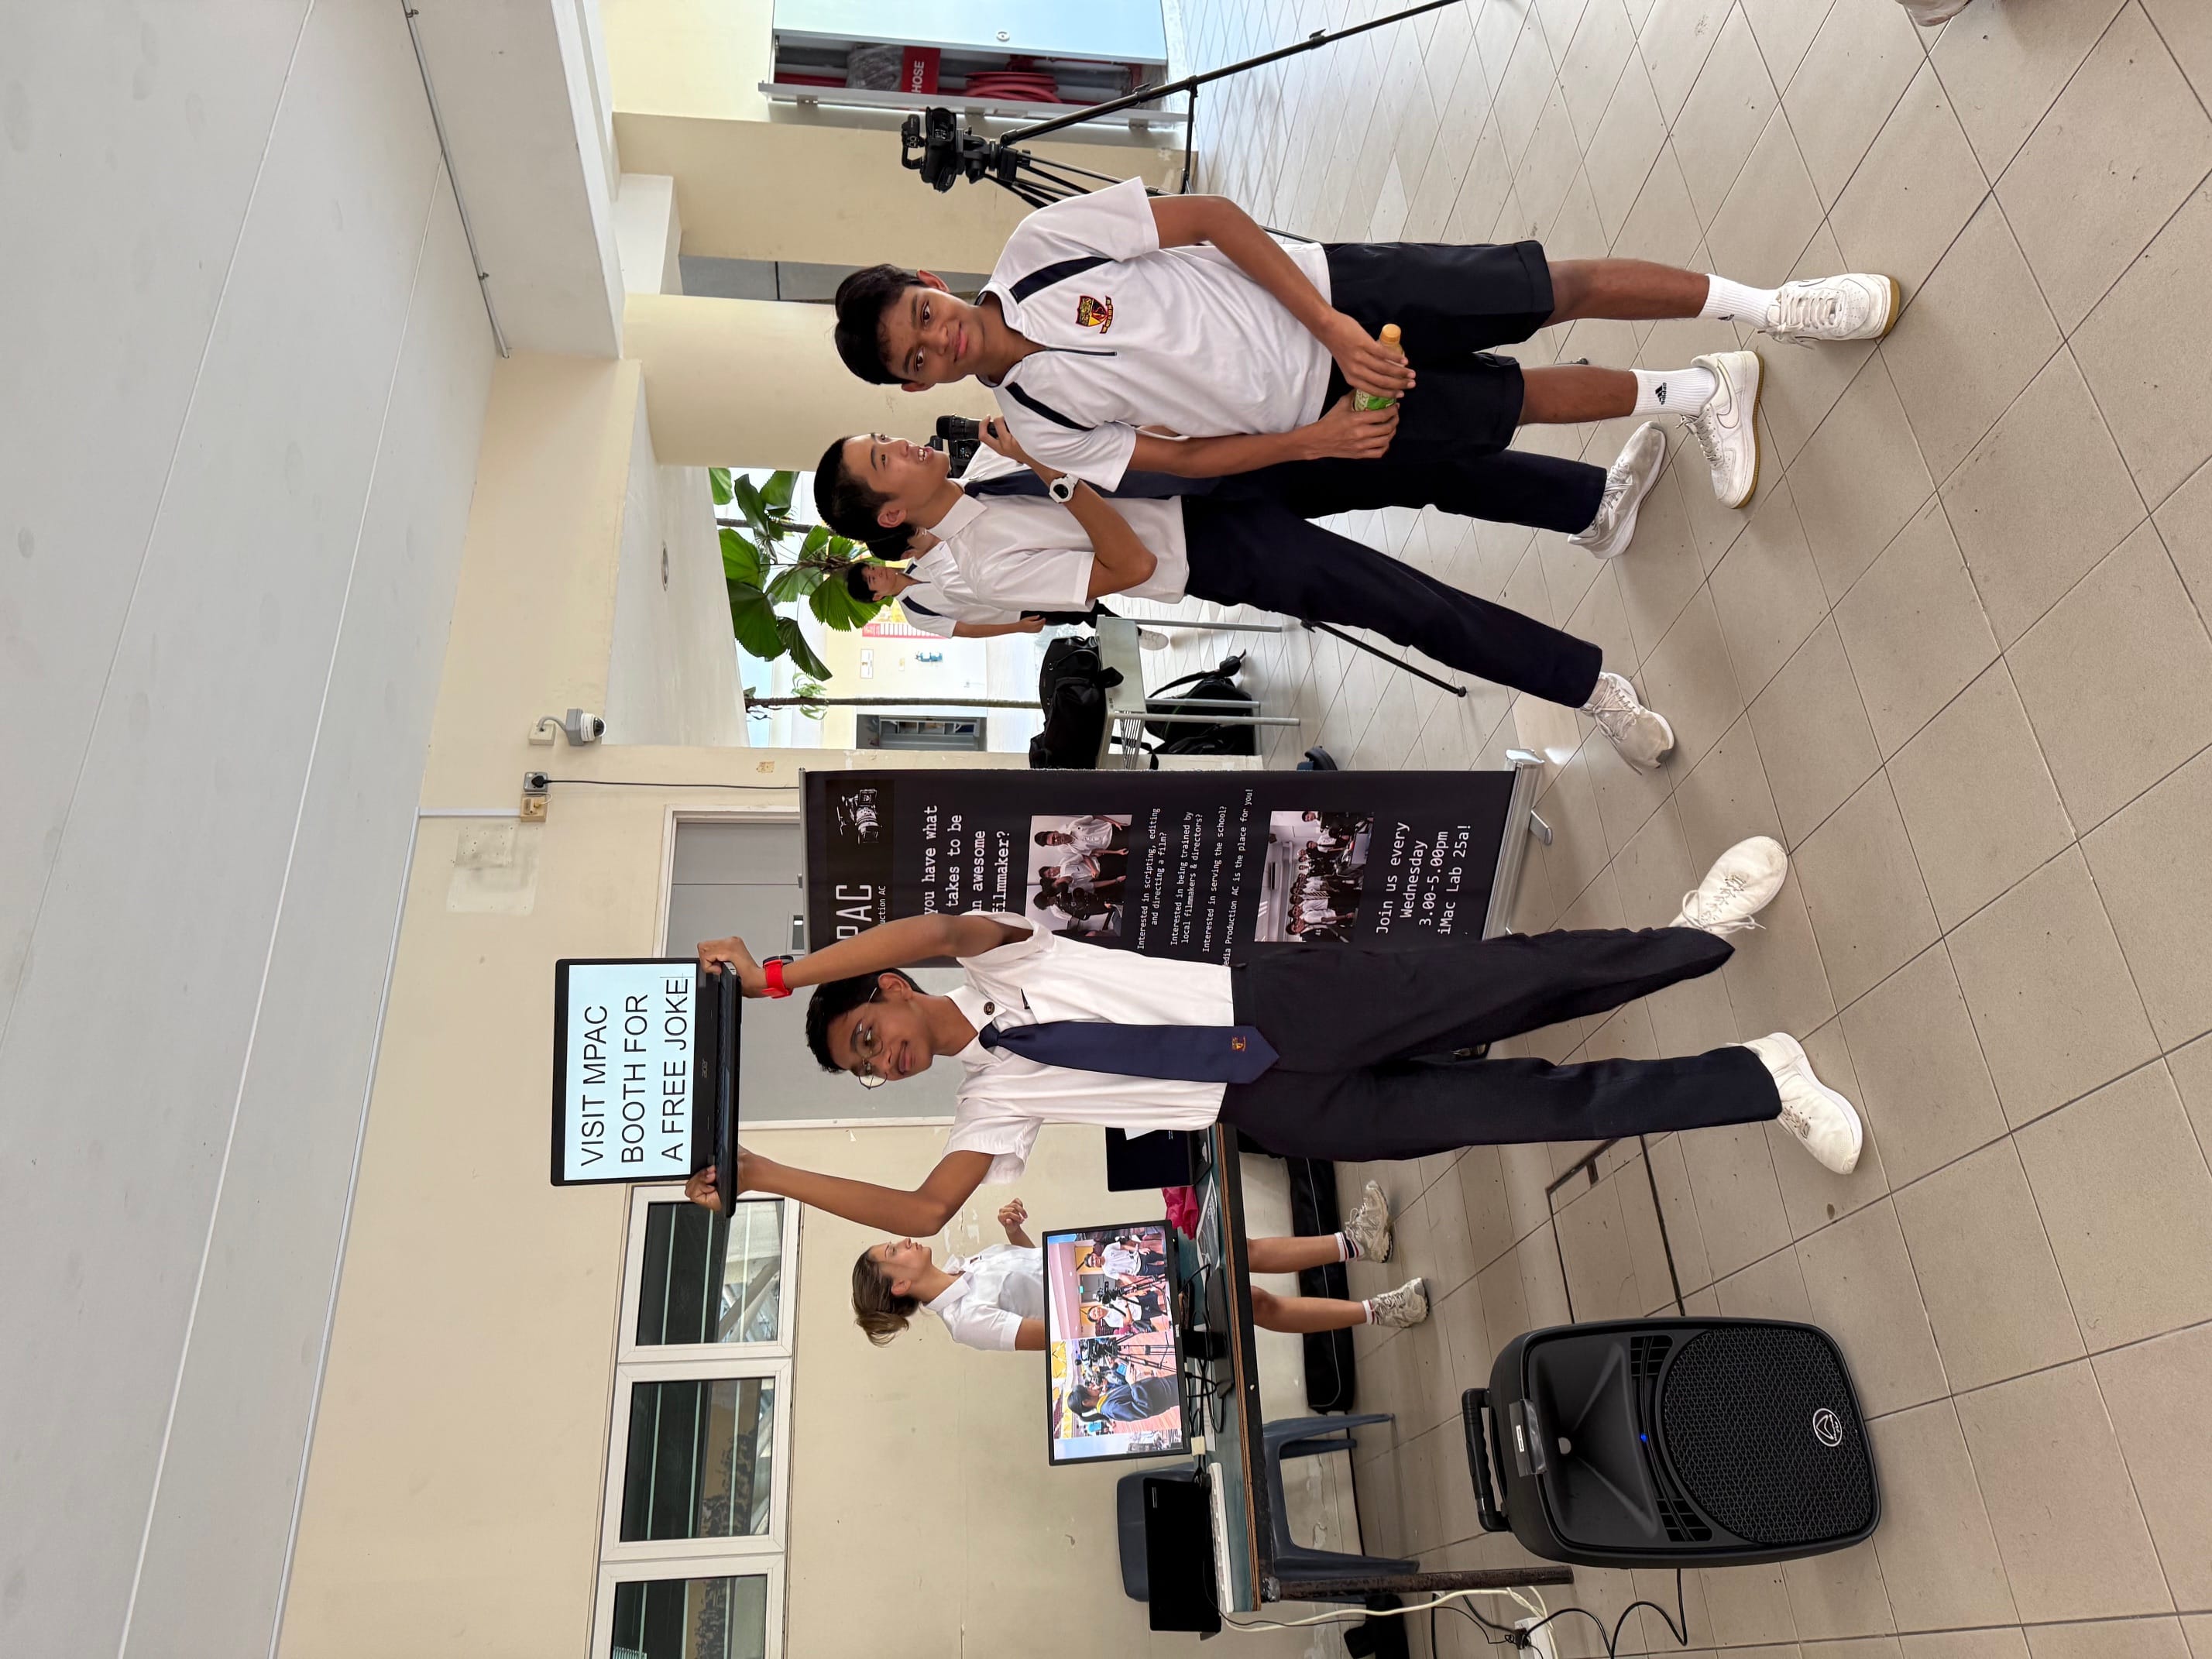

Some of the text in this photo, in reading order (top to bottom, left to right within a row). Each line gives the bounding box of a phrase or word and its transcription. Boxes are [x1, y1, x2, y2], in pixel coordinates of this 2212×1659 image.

[911, 60, 925, 93] HOSE
[1181, 825, 1190, 857] trained
[1191, 814, 1202, 860] directors?
[1217, 806, 1226, 837] school?
[1238, 827, 1246, 850] place
[922, 805, 938, 915] you have what
[946, 816, 961, 907] takes to be
[973, 831, 985, 891] awesome
[1138, 809, 1160, 949] Interested in scripting, editing
[1152, 868, 1164, 908] directing
[1158, 833, 1166, 856] film?
[1177, 862, 1188, 884] being
[1211, 860, 1221, 891] serving
[1233, 873, 1240, 881] is
[1376, 823, 1410, 933] Join us every
[1400, 840, 1428, 917] Wednesday
[1419, 832, 1448, 926] 3.00-5.00pm
[1437, 826, 1470, 934] iMac Lab 25a!
[836, 885, 872, 939] PAC
[878, 886, 886, 923] uction AC
[1176, 889, 1183, 898] in
[1184, 874, 1196, 917] filmmakers
[1208, 896, 1215, 905] in
[1231, 886, 1238, 895] AC
[1171, 902, 1181, 945] Interested
[1181, 922, 1190, 943] local
[1203, 909, 1214, 952] Interested
[1225, 901, 1237, 943] Production
[1222, 949, 1231, 966] edia
[581, 1006, 607, 1166] VISIT MPAC
[622, 995, 647, 1163] BOOTH FOR
[661, 979, 688, 1161] A FREE JOKE
